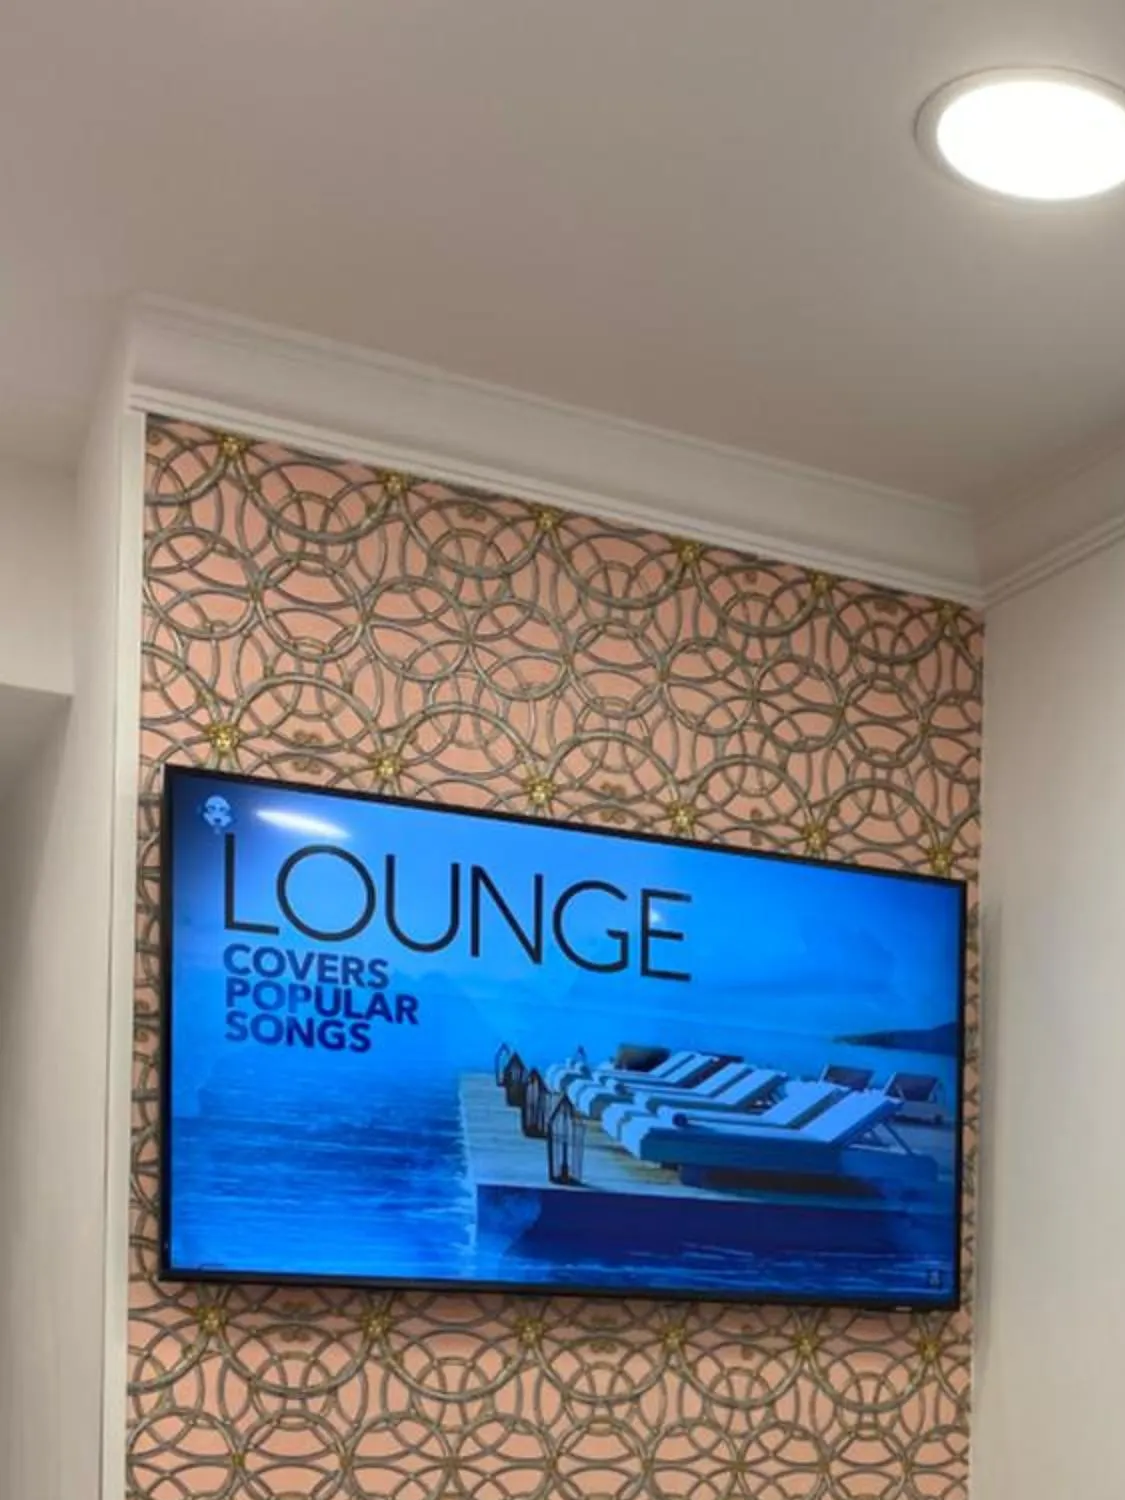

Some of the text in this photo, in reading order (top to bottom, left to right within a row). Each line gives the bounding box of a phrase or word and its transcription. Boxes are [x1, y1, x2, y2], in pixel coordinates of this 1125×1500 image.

[224, 832, 693, 982] LOUNGE
[224, 943, 390, 990] COVERS
[225, 977, 420, 1025] POPULAR
[225, 1011, 372, 1054] SONGS
